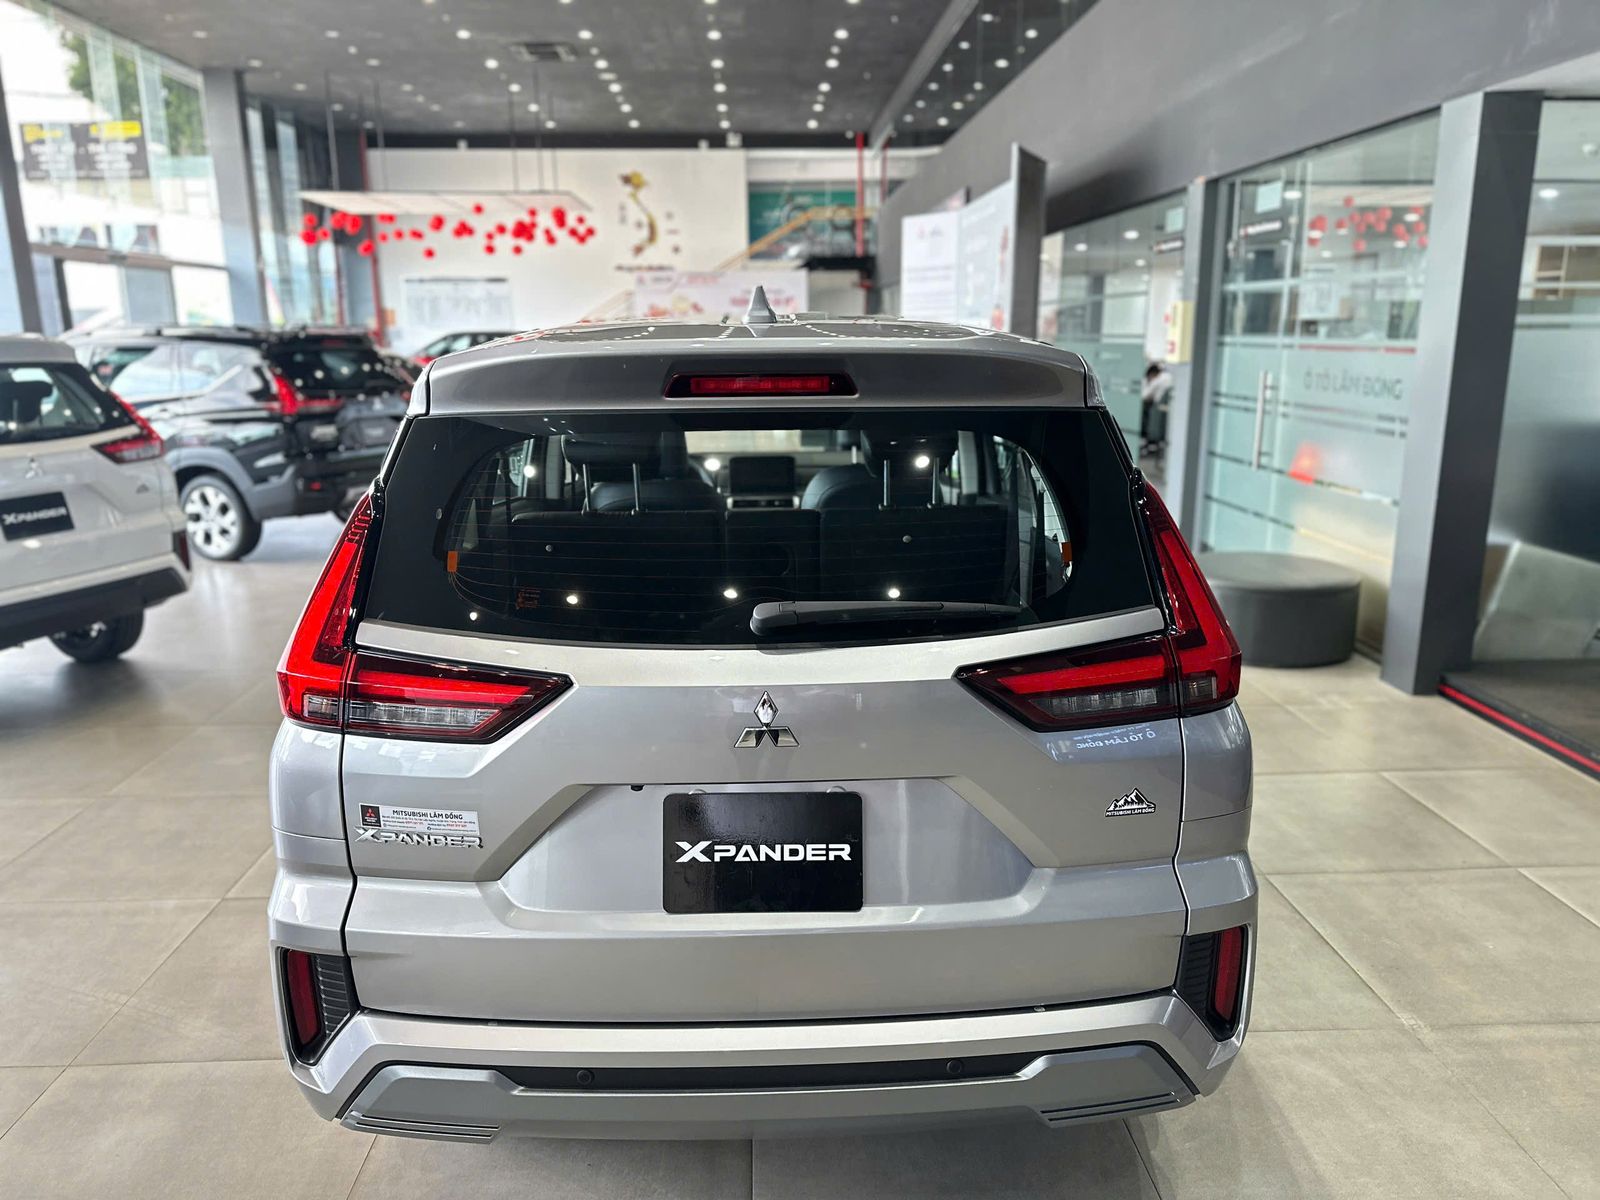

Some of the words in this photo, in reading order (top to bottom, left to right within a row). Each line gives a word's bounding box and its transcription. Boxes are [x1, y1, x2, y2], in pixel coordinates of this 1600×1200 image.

[2, 506, 67, 525] XPANDER
[392, 809, 429, 818] MITSUBISHI
[429, 811, 444, 820] LÂM
[354, 826, 484, 849] XPANDER
[675, 840, 852, 863] XPANDER
